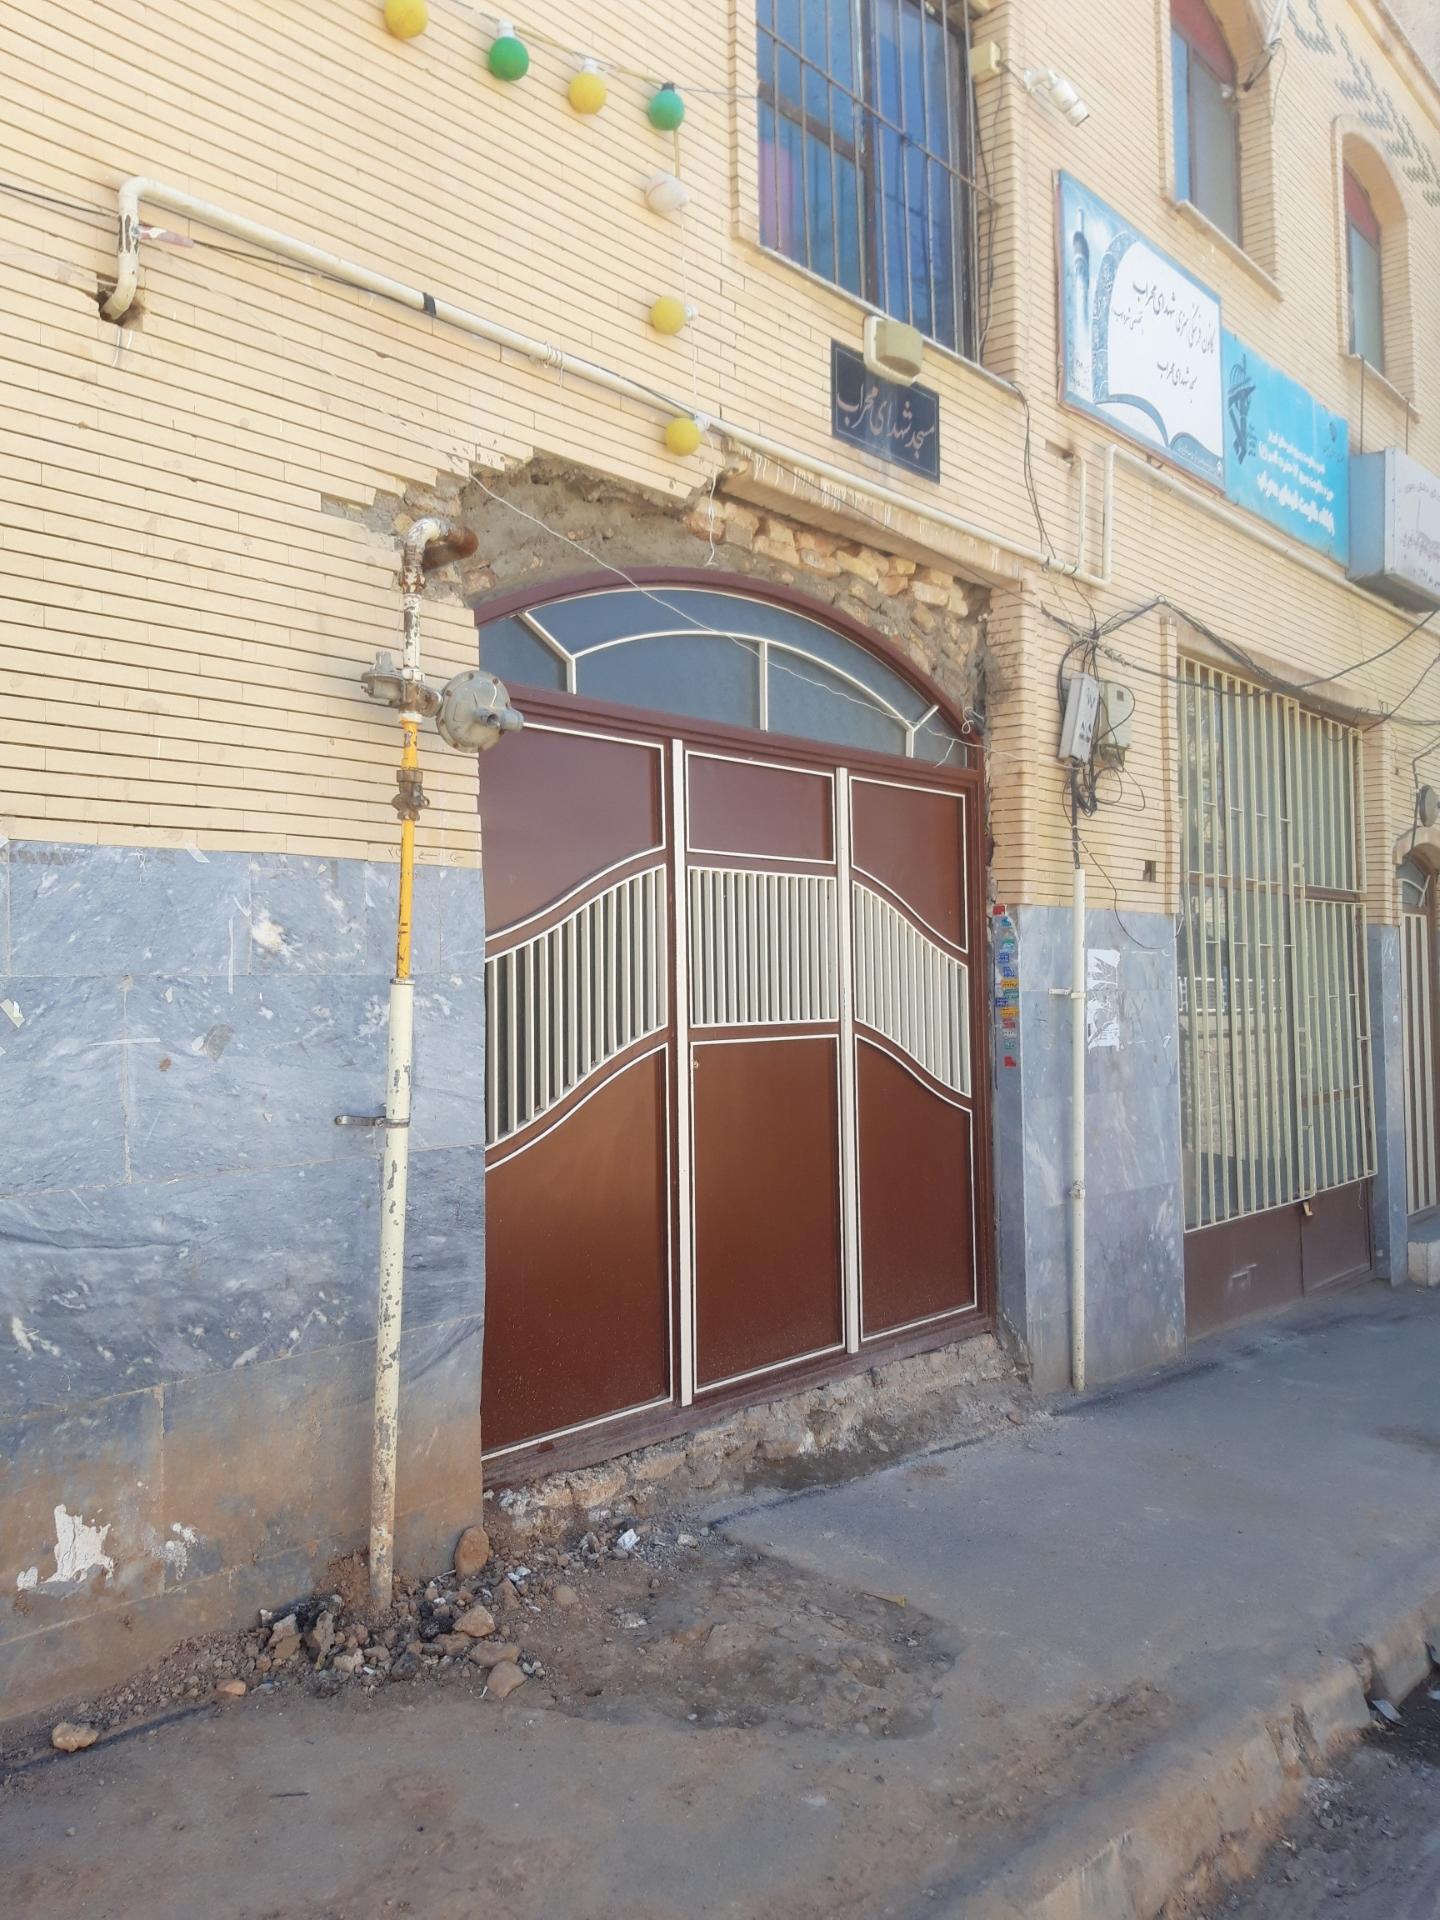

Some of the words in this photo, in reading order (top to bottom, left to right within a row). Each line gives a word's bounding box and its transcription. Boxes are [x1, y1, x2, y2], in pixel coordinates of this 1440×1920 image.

[1132, 280, 1157, 306] محراب
[1153, 290, 1175, 316] شهدای
[1156, 361, 1175, 380] محراب
[1171, 366, 1190, 386] شهدای
[836, 383, 879, 429] محراب
[869, 400, 913, 440] شهدای
[904, 425, 935, 459] مسجد
